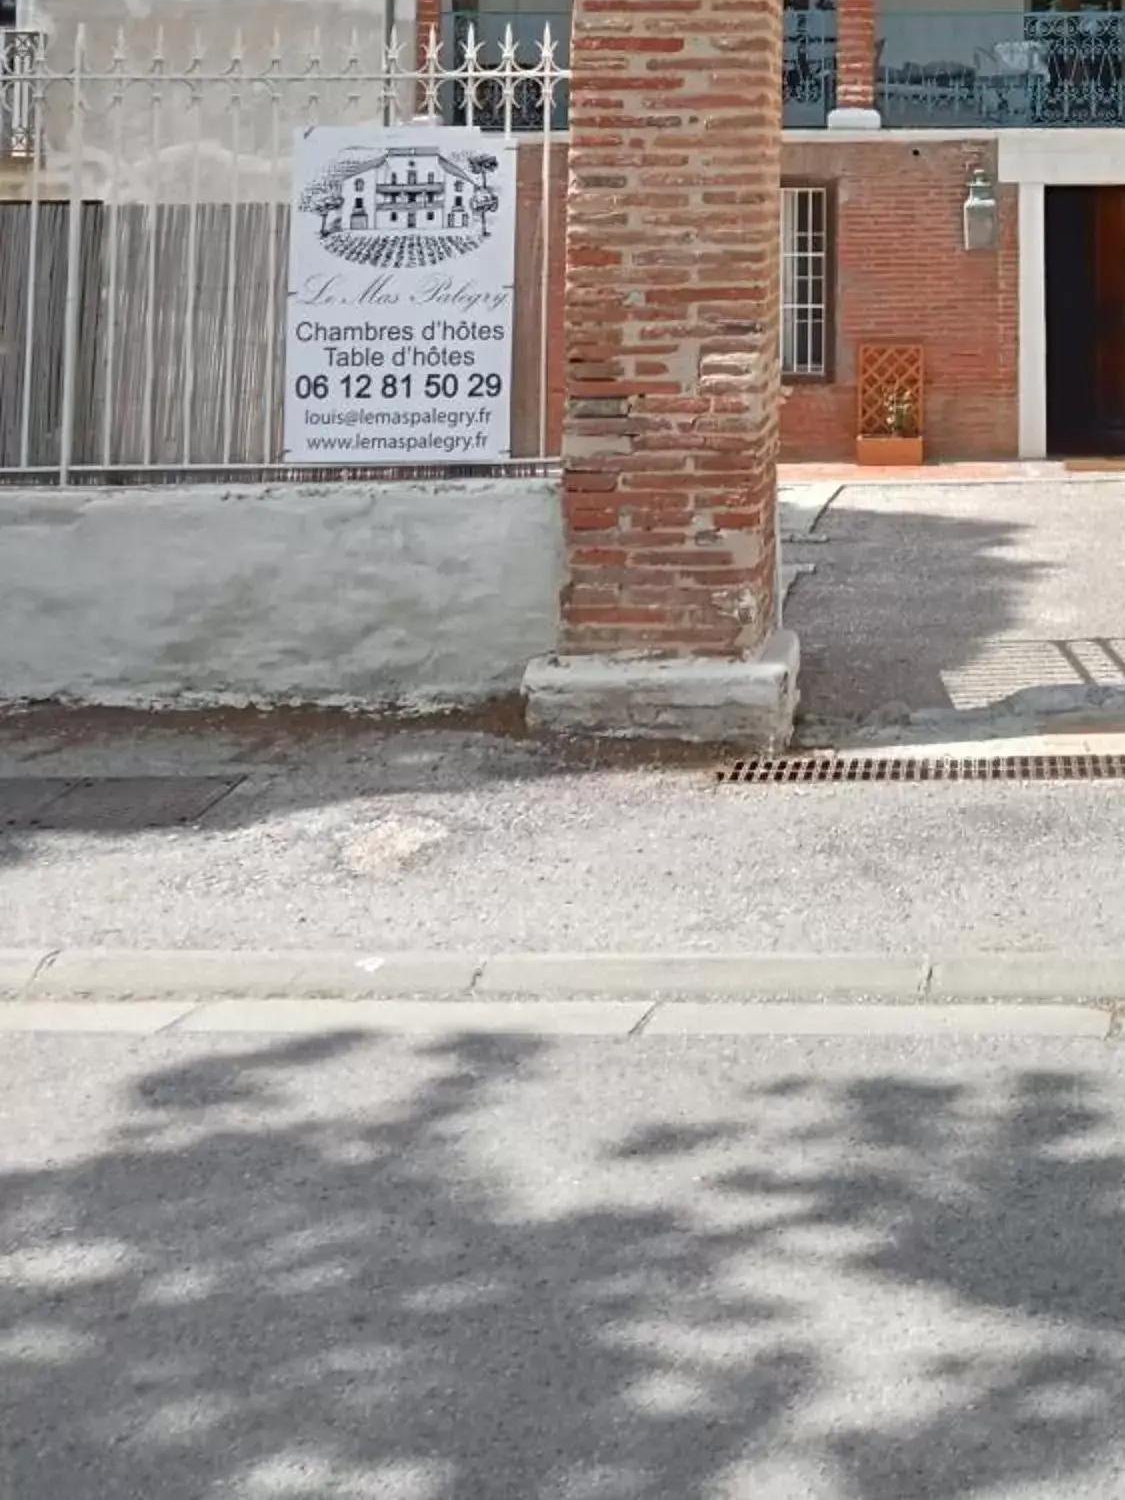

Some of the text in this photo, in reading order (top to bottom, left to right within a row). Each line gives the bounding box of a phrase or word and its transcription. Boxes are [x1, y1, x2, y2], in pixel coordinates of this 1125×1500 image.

[301, 273, 508, 312] Le Mas Palegry
[295, 320, 505, 342] Chambres d'hôtes
[323, 346, 476, 367] Table d'hôtes
[295, 373, 503, 399] 06 12 81 50 29
[304, 407, 492, 427] louis@lemaspalegry.fr
[306, 431, 489, 452] www.lemaspalegry.fr
